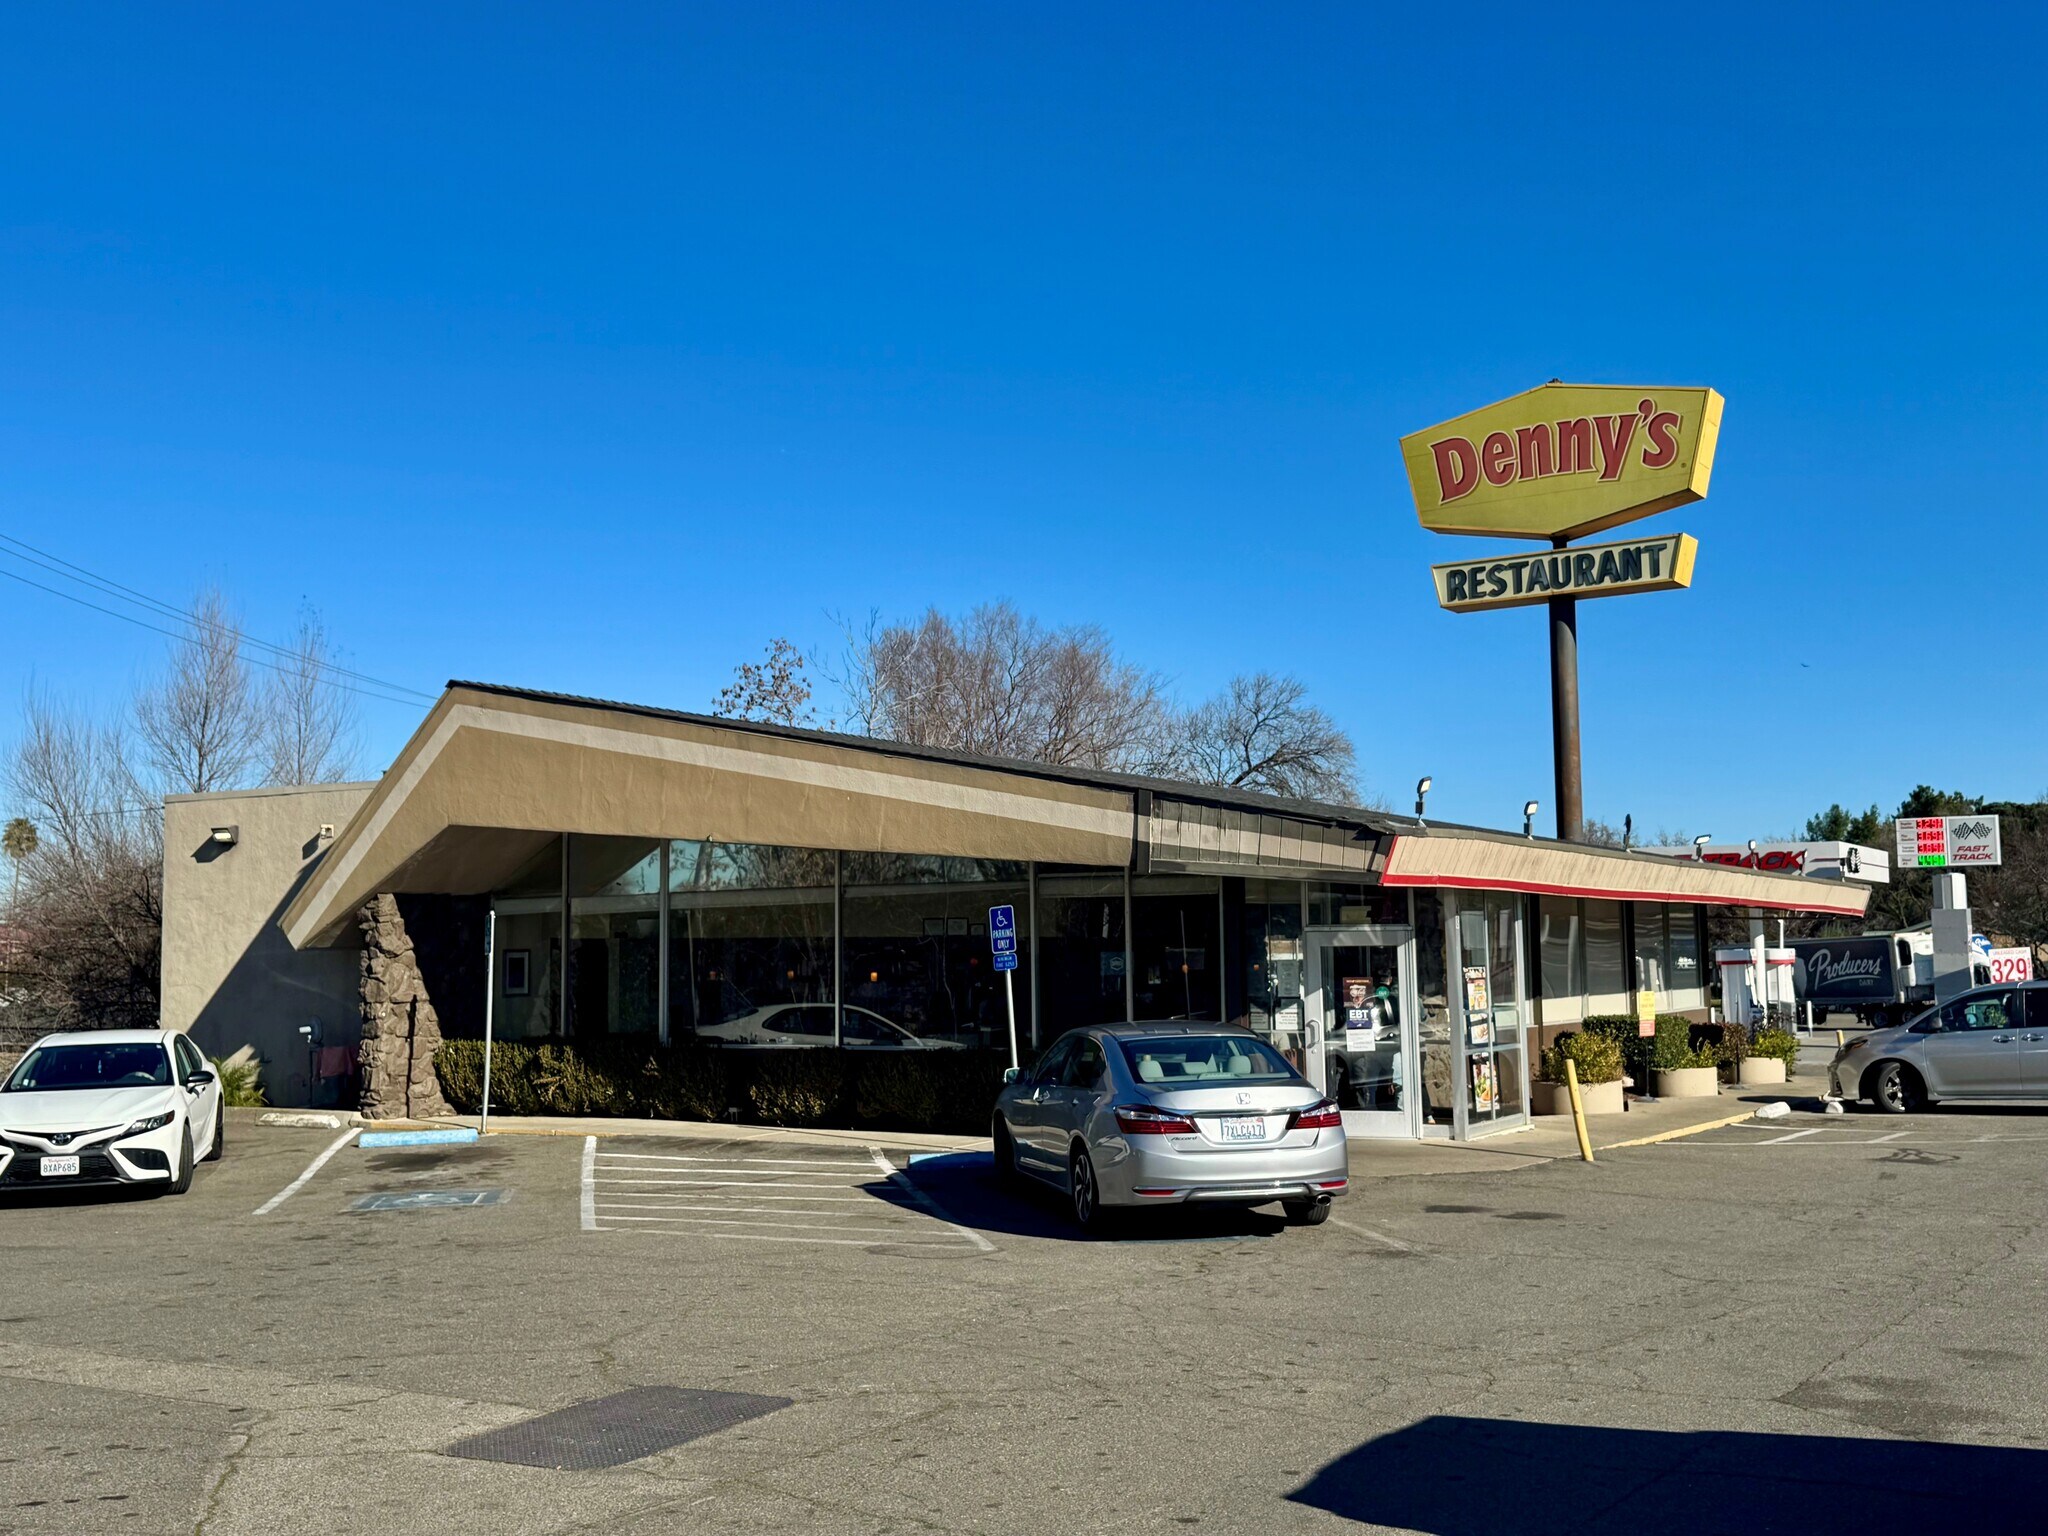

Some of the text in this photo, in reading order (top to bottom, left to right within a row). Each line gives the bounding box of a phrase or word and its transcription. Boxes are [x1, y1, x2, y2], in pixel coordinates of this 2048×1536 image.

[1428, 398, 1681, 505] Denny's
[1446, 543, 1668, 603] RESTAURANT
[1953, 853, 1993, 861] TRACK
[993, 928, 1013, 939] PARKING
[997, 939, 1009, 949] ONLY
[1808, 948, 1882, 991] Producers
[1991, 957, 2027, 984] 329
[1349, 1009, 1369, 1019] EBT
[43, 1163, 77, 1173] 8XAP685
